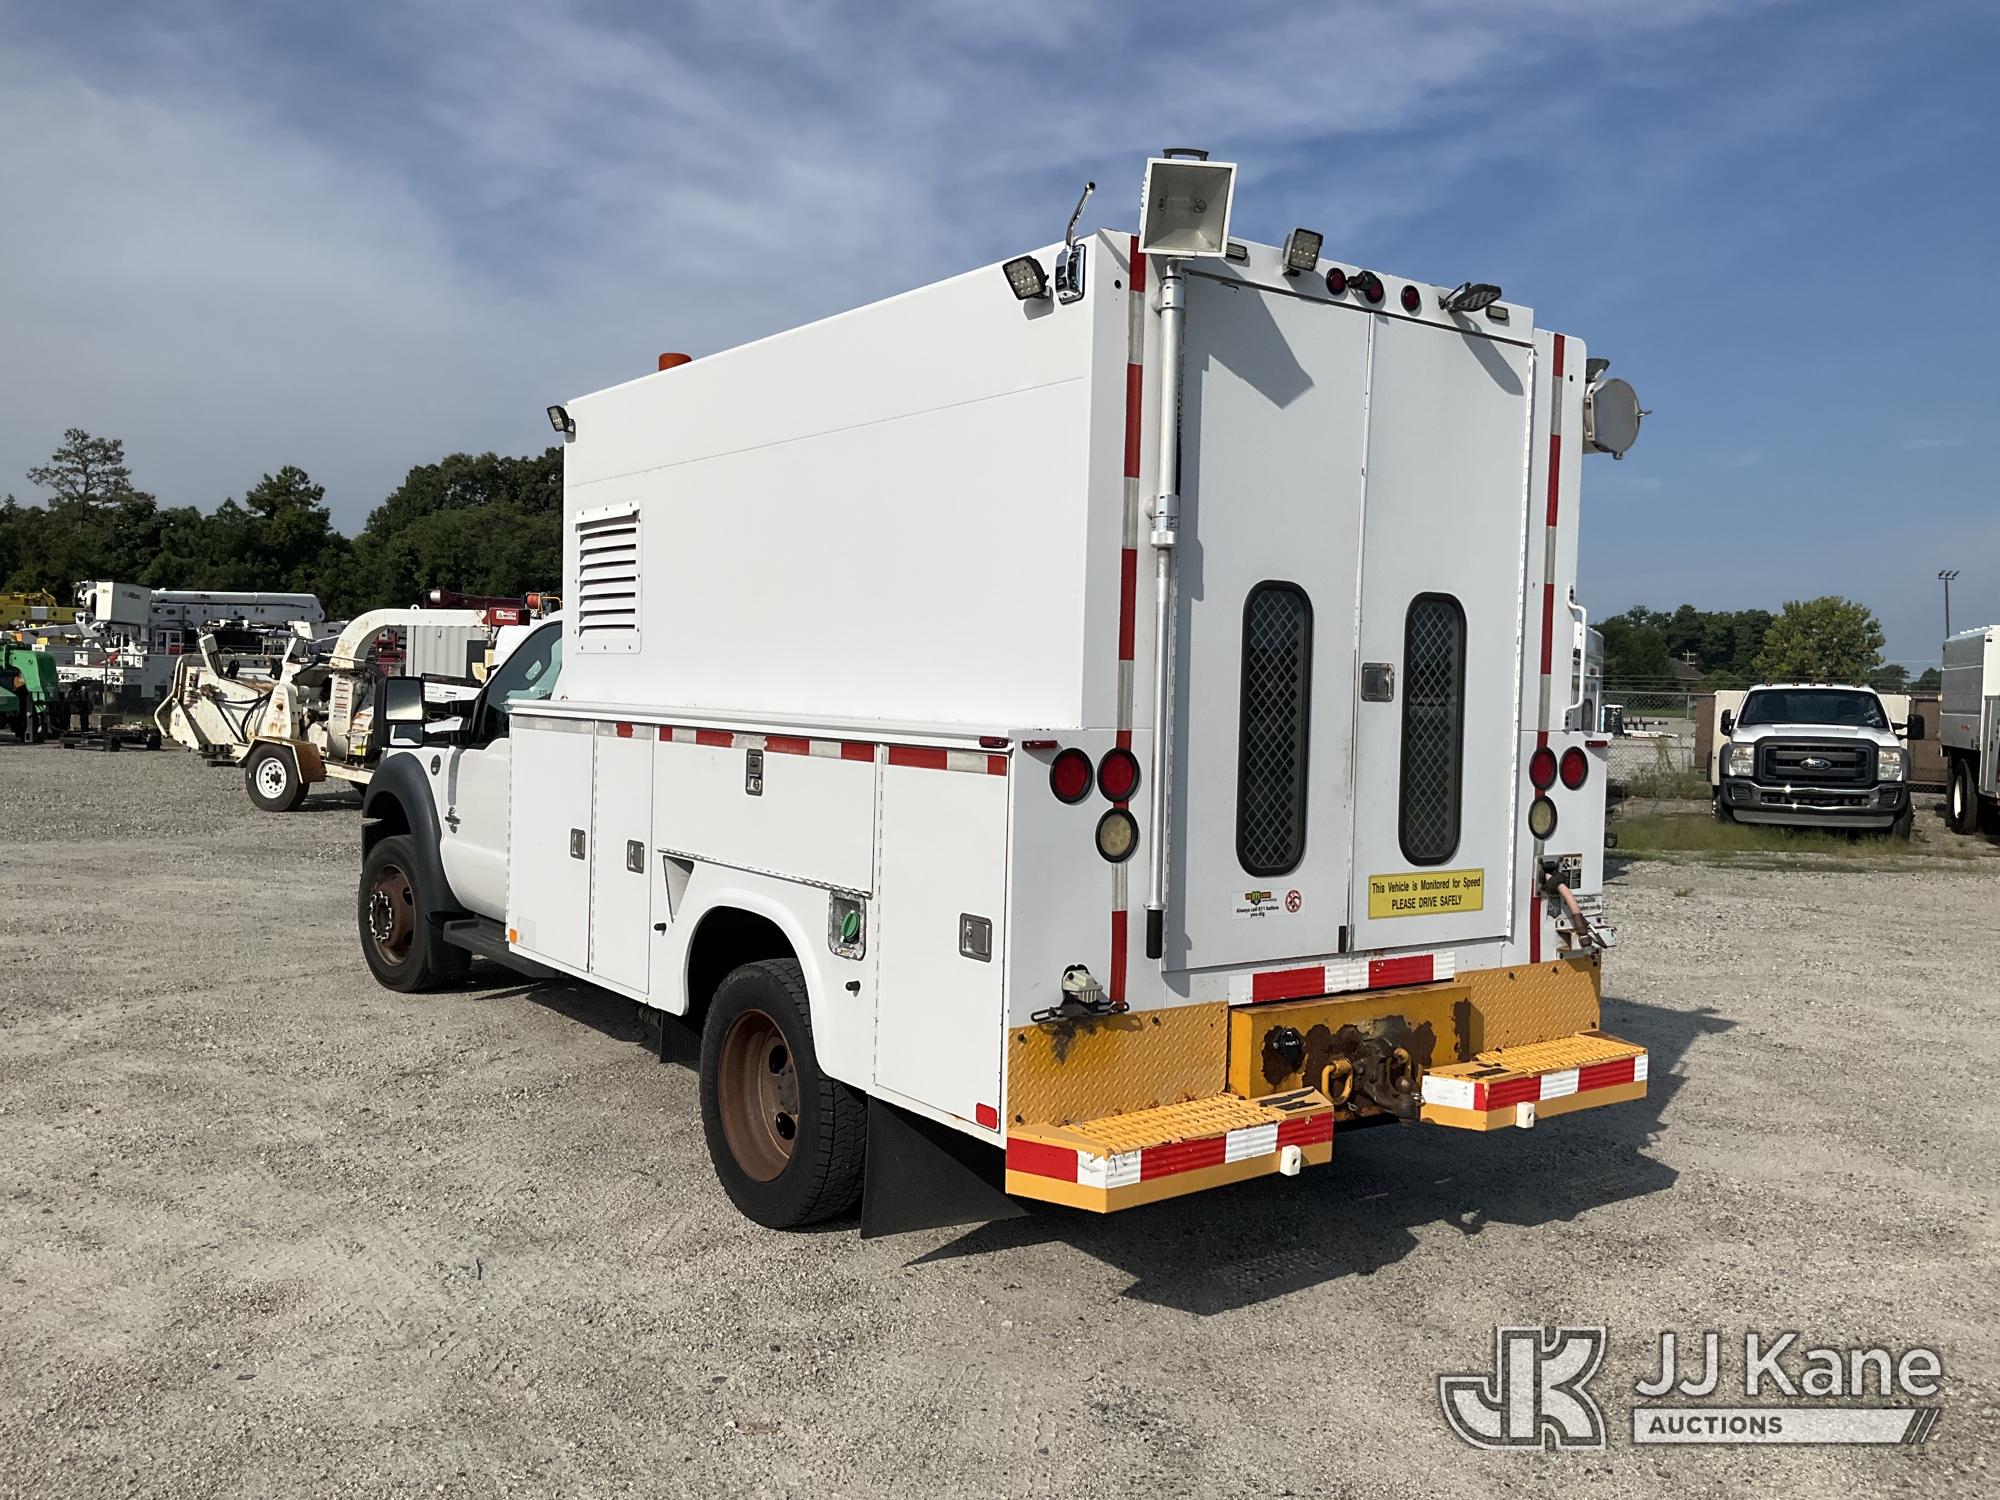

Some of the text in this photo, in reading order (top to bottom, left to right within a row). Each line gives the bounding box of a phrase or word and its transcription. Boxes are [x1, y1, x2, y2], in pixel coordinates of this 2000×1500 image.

[1372, 877, 1481, 894] This Vehicle is Monitored for Speed
[1391, 894, 1462, 910] PLEASE DRIVE SAFELY
